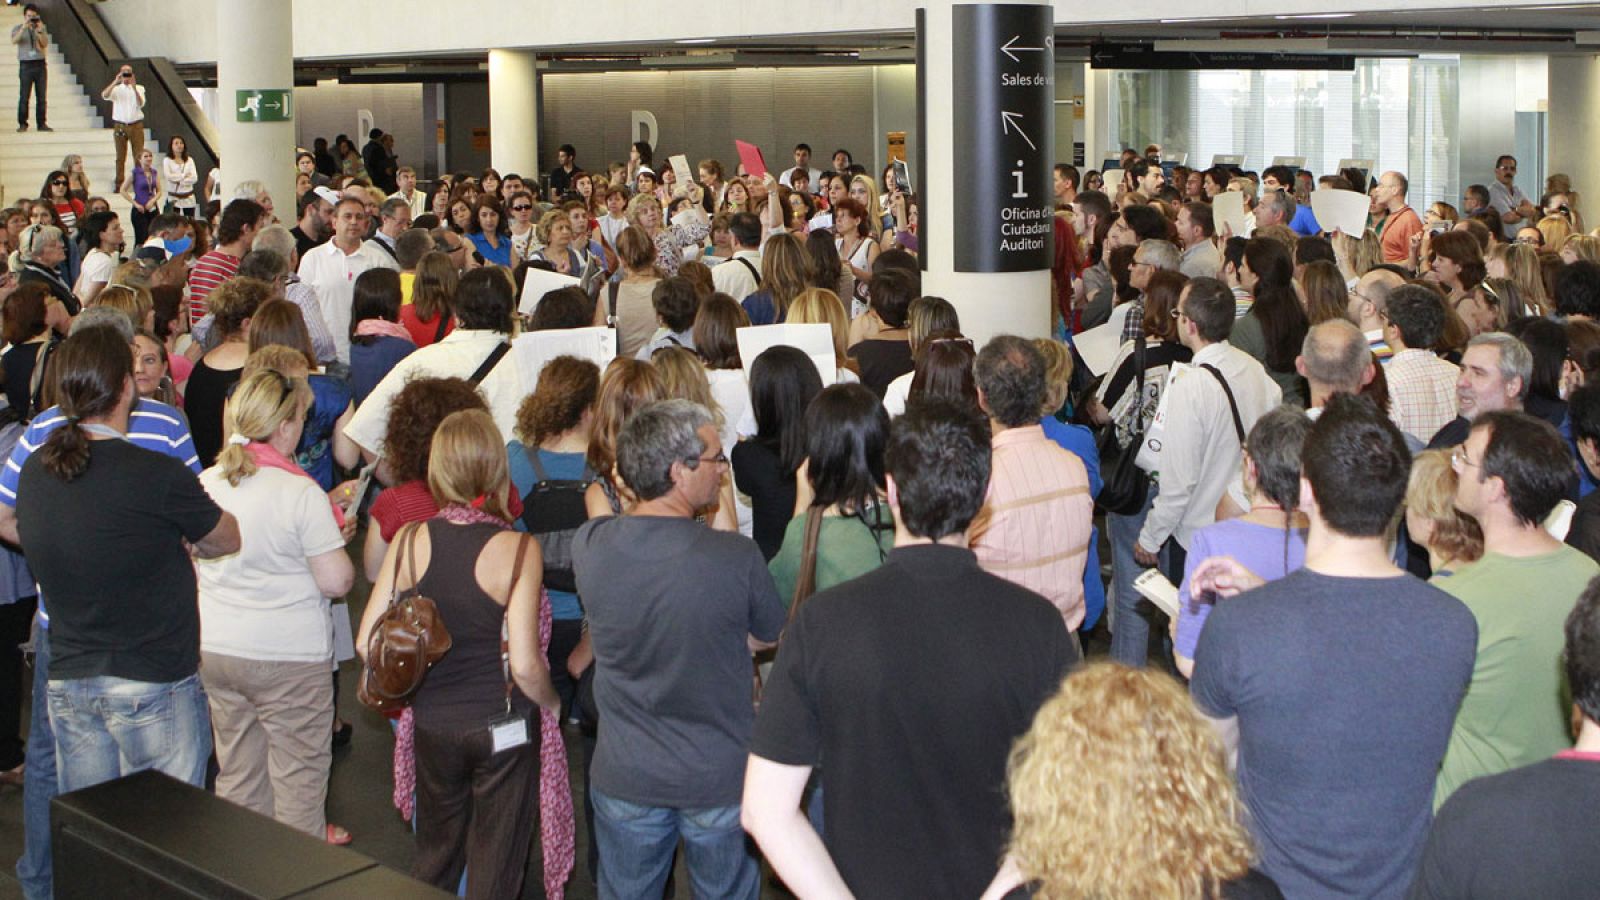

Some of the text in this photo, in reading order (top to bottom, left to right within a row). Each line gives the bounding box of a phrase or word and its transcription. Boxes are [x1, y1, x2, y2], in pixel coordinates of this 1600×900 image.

[1002, 72, 1032, 86] Sales
[1034, 72, 1045, 86] de
[632, 110, 658, 153] D
[1011, 159, 1028, 198] i
[1001, 207, 1041, 221] Oficina
[1000, 236, 1044, 251] Auditori
